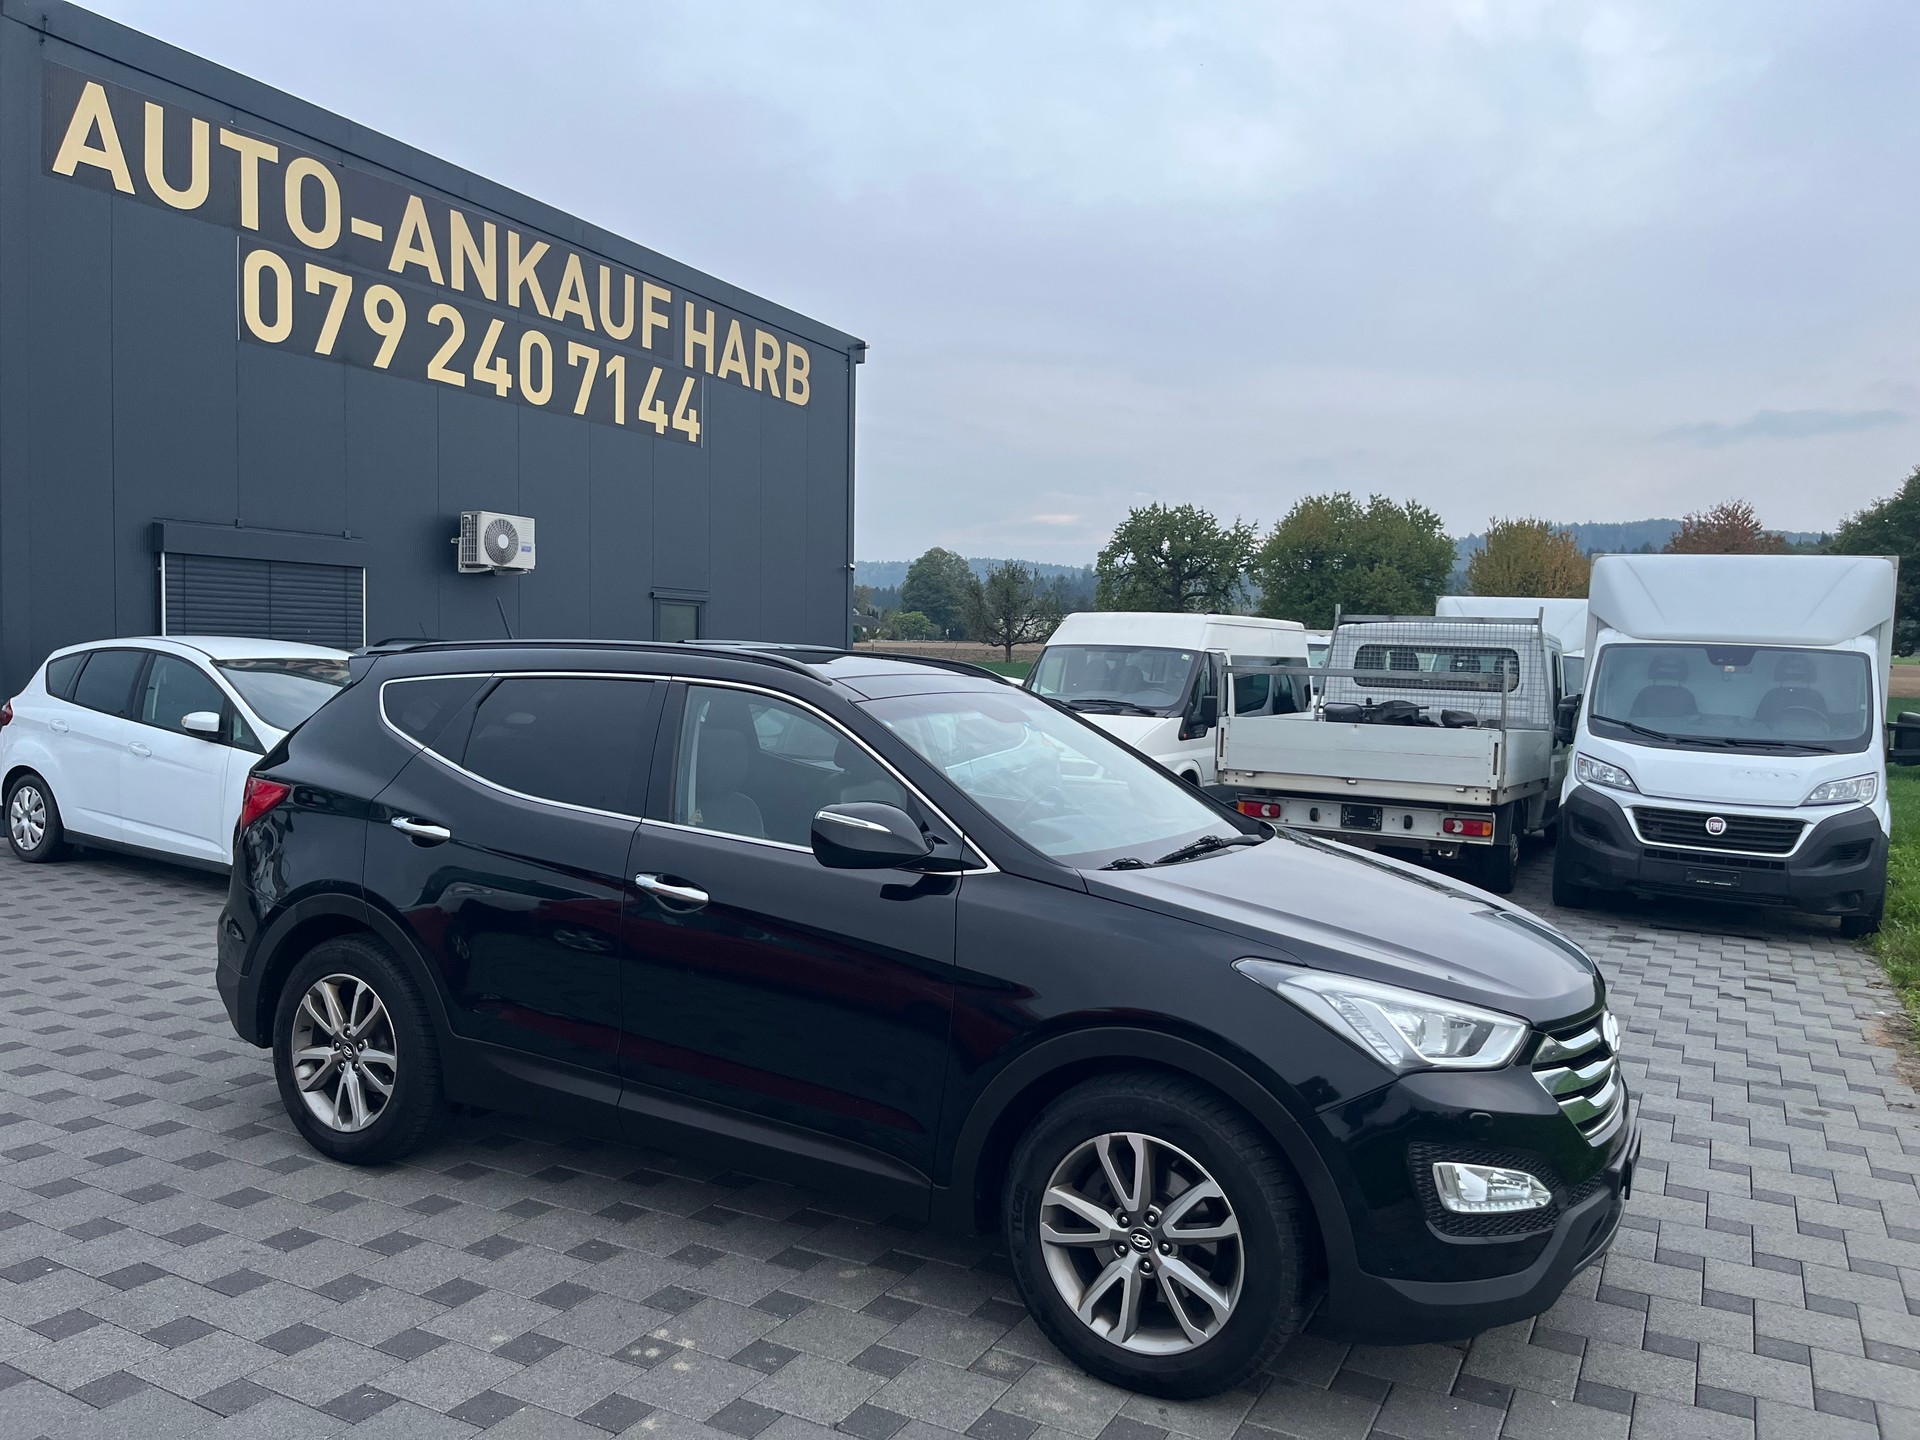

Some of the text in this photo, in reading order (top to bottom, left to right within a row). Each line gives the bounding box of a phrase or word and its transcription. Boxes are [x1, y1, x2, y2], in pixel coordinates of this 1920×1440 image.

[52, 81, 811, 407] AUTO-ANKAUF HARB
[243, 249, 702, 443] 079 240 7144
[1709, 821, 1722, 831] FIAT
